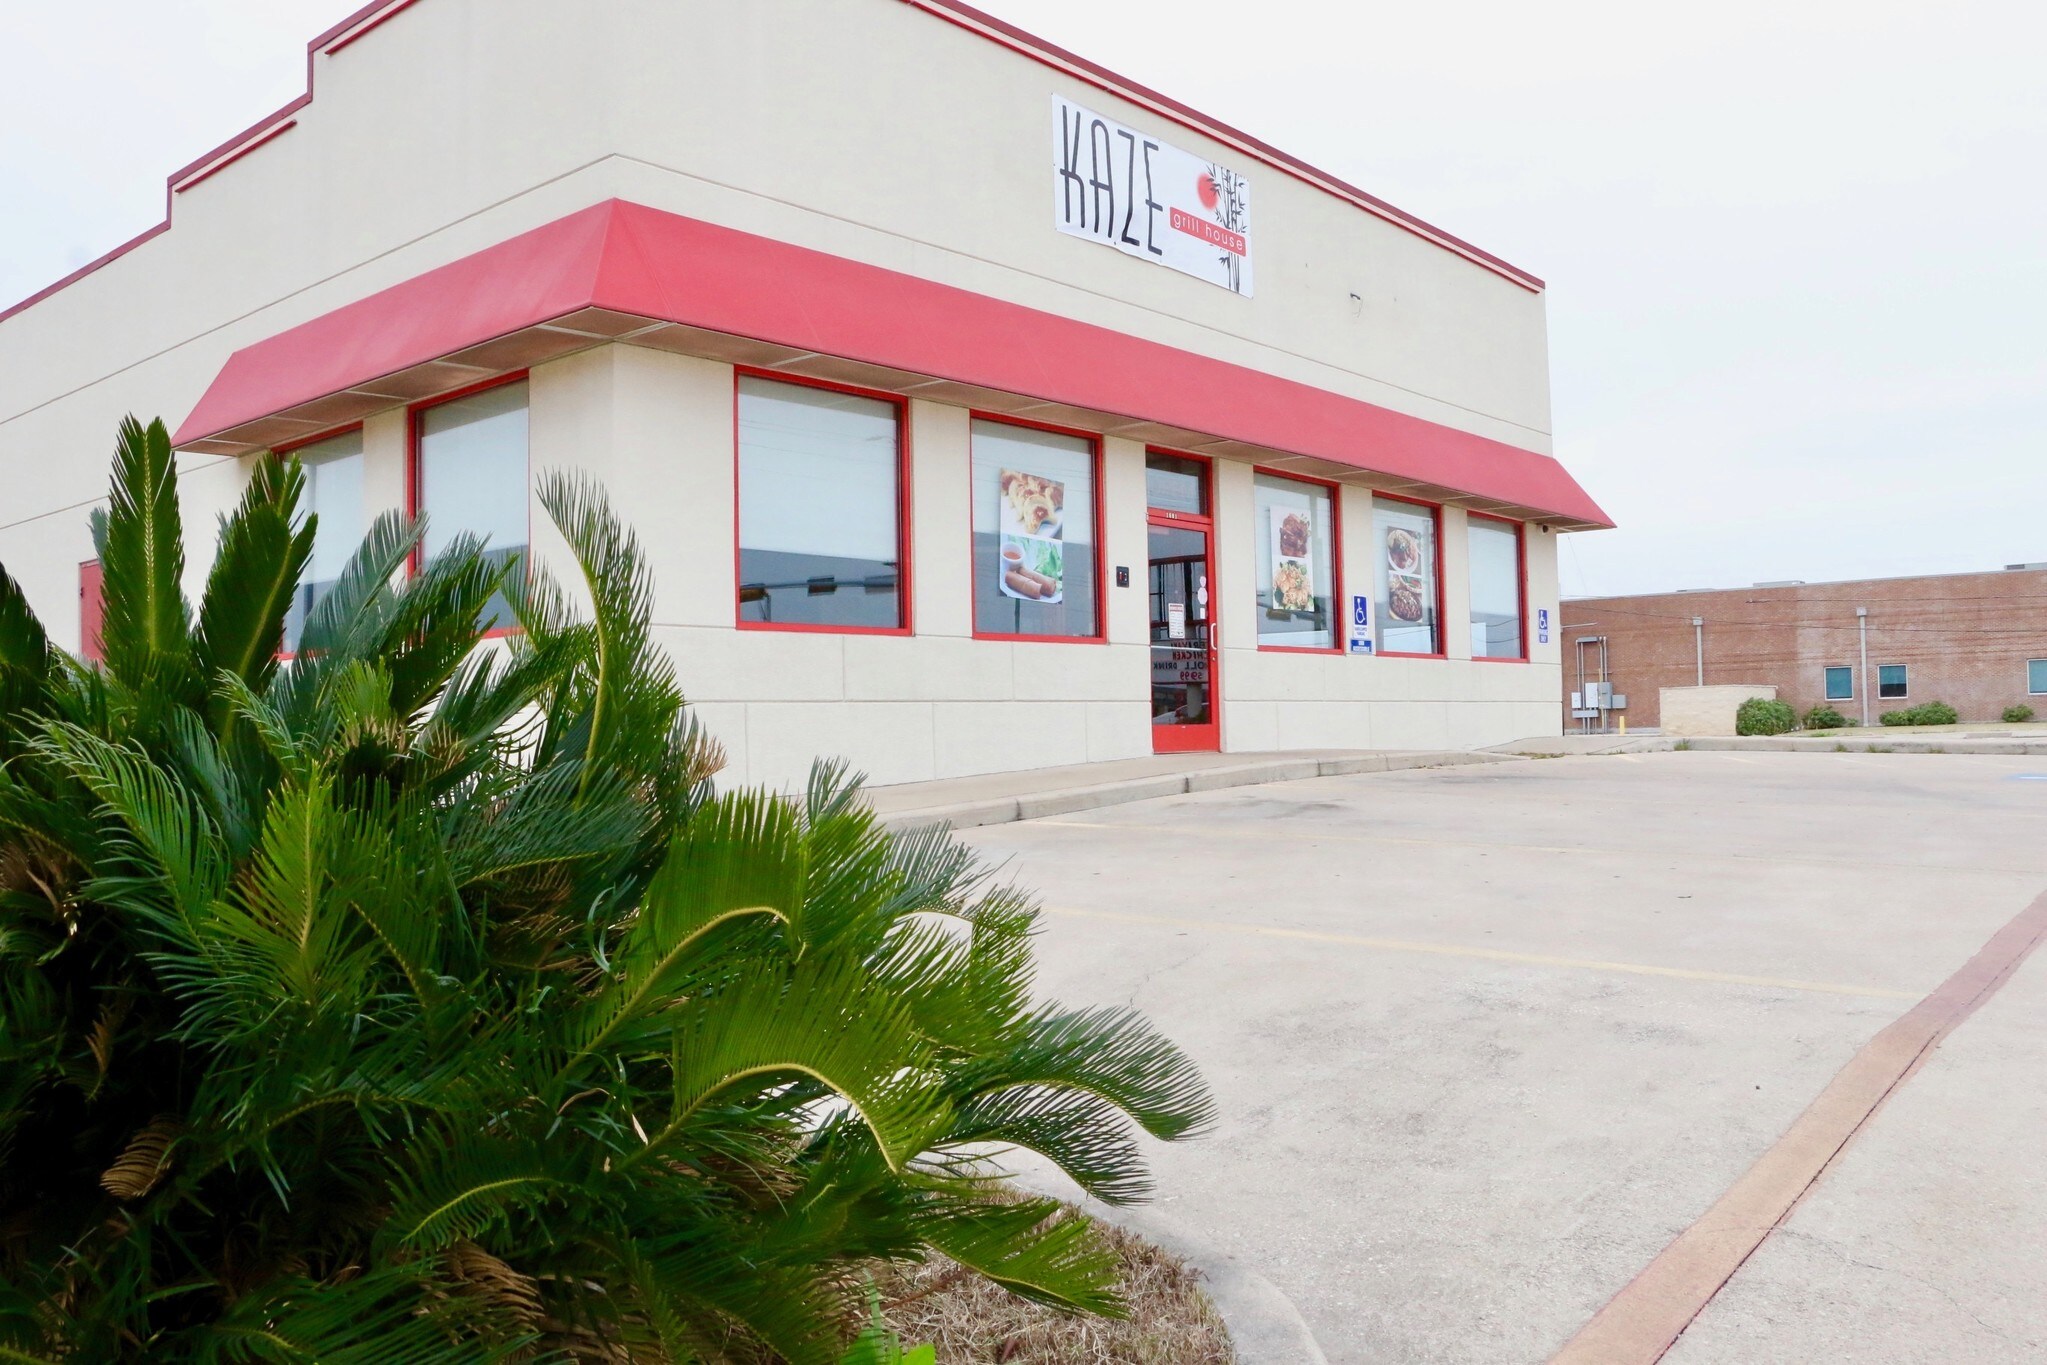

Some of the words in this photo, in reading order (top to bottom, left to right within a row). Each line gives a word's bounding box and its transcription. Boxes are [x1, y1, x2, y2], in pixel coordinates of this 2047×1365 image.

[1060, 104, 1163, 256] KAZE
[1173, 213, 1199, 233] grill
[1205, 223, 1243, 251] house
